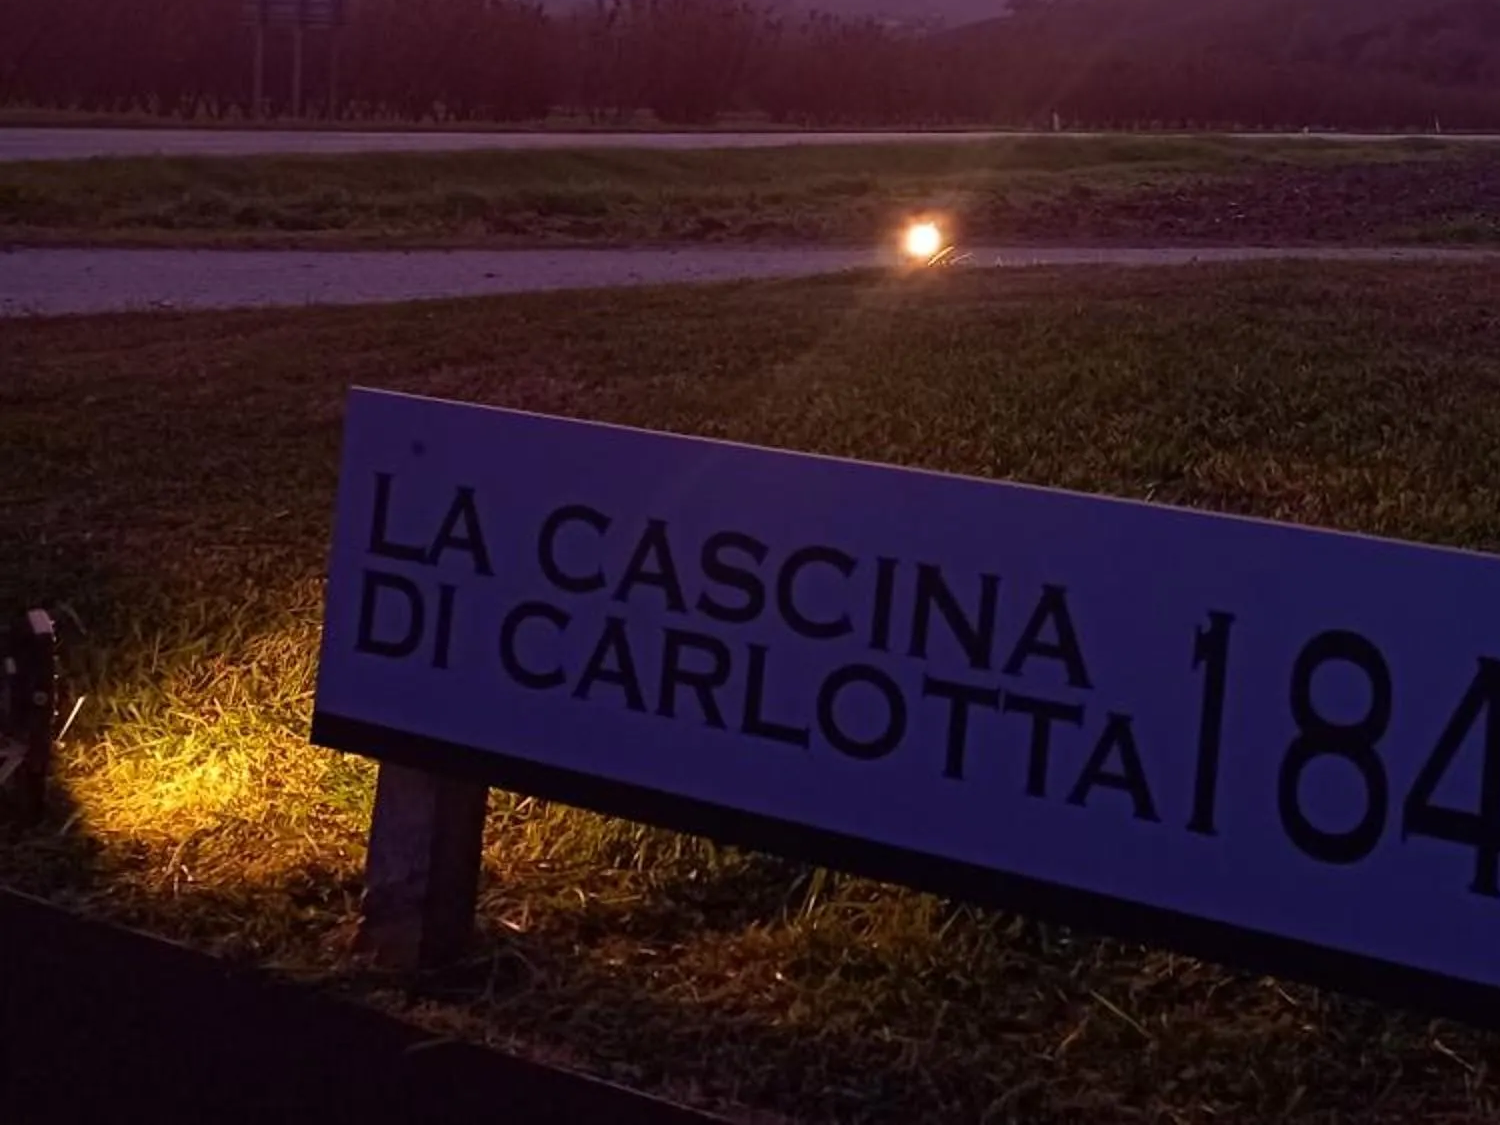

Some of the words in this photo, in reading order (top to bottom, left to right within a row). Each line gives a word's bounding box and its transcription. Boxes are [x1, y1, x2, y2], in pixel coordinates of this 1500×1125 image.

[356, 570, 454, 669] DI
[500, 601, 1159, 822] CARLOTTA
[369, 473, 492, 576] LA
[538, 504, 1092, 689] CASCINA
